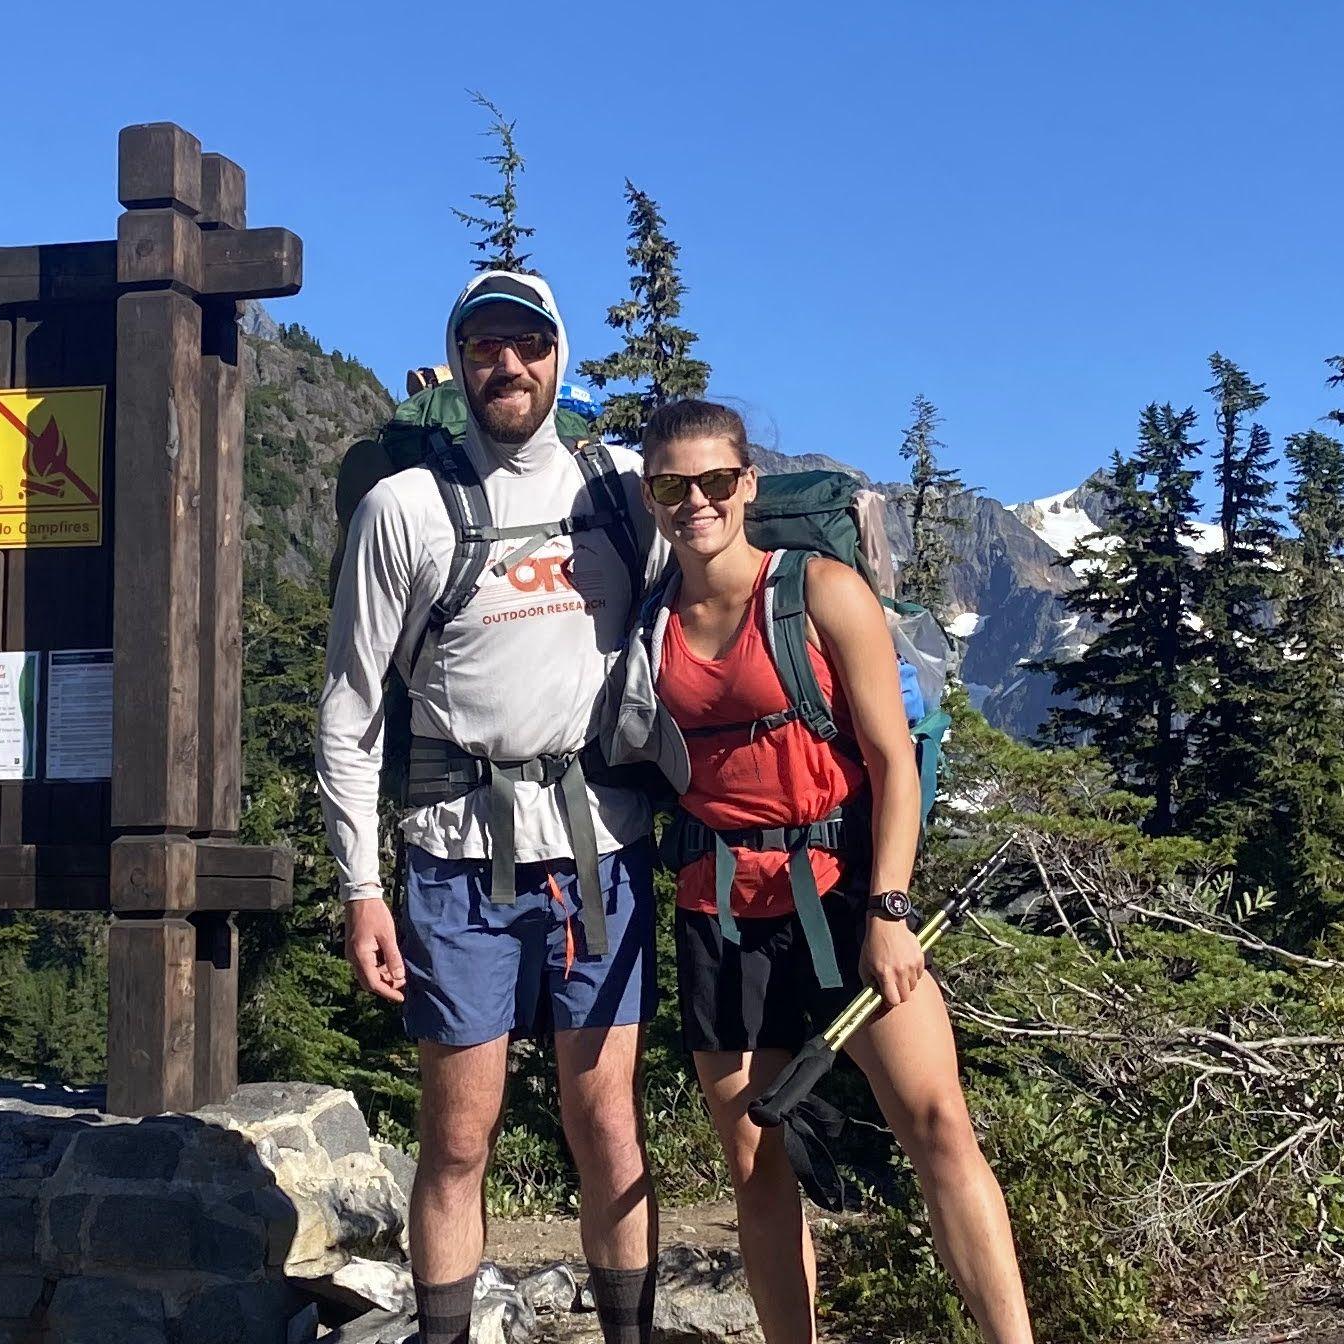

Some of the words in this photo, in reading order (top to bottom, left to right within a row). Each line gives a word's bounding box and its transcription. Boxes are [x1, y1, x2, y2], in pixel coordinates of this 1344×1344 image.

[18, 520, 90, 535] Campfires
[482, 606, 545, 625] OUTDOOR
[547, 599, 606, 615] RESEARCH
